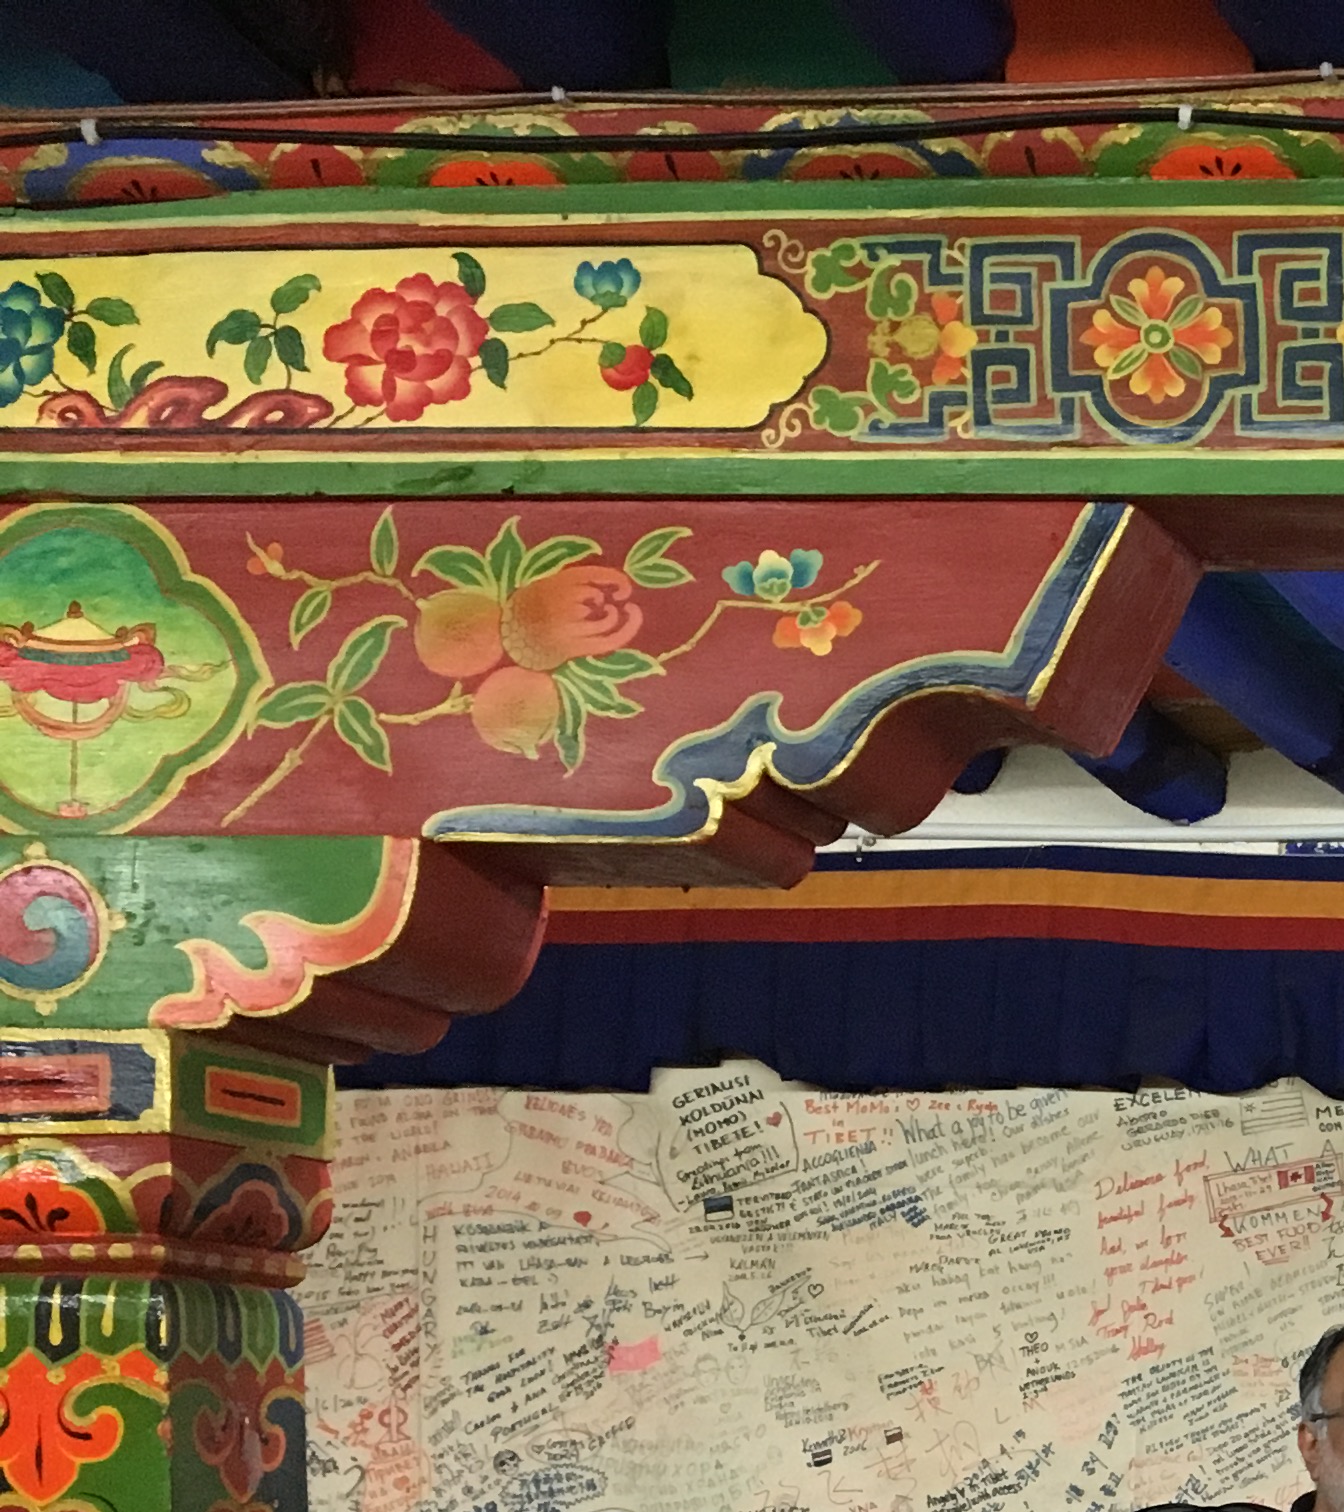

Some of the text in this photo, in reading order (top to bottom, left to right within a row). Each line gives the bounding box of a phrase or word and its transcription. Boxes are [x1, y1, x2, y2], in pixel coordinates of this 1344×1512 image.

[672, 1074, 750, 1110] GERIAUSI
[804, 1099, 839, 1114] Best
[896, 1113, 945, 1144] What
[1006, 1100, 1027, 1120] be
[908, 1142, 948, 1168] lunch
[1224, 1143, 1294, 1172] WHAT
[1019, 1342, 1048, 1357] THEO
